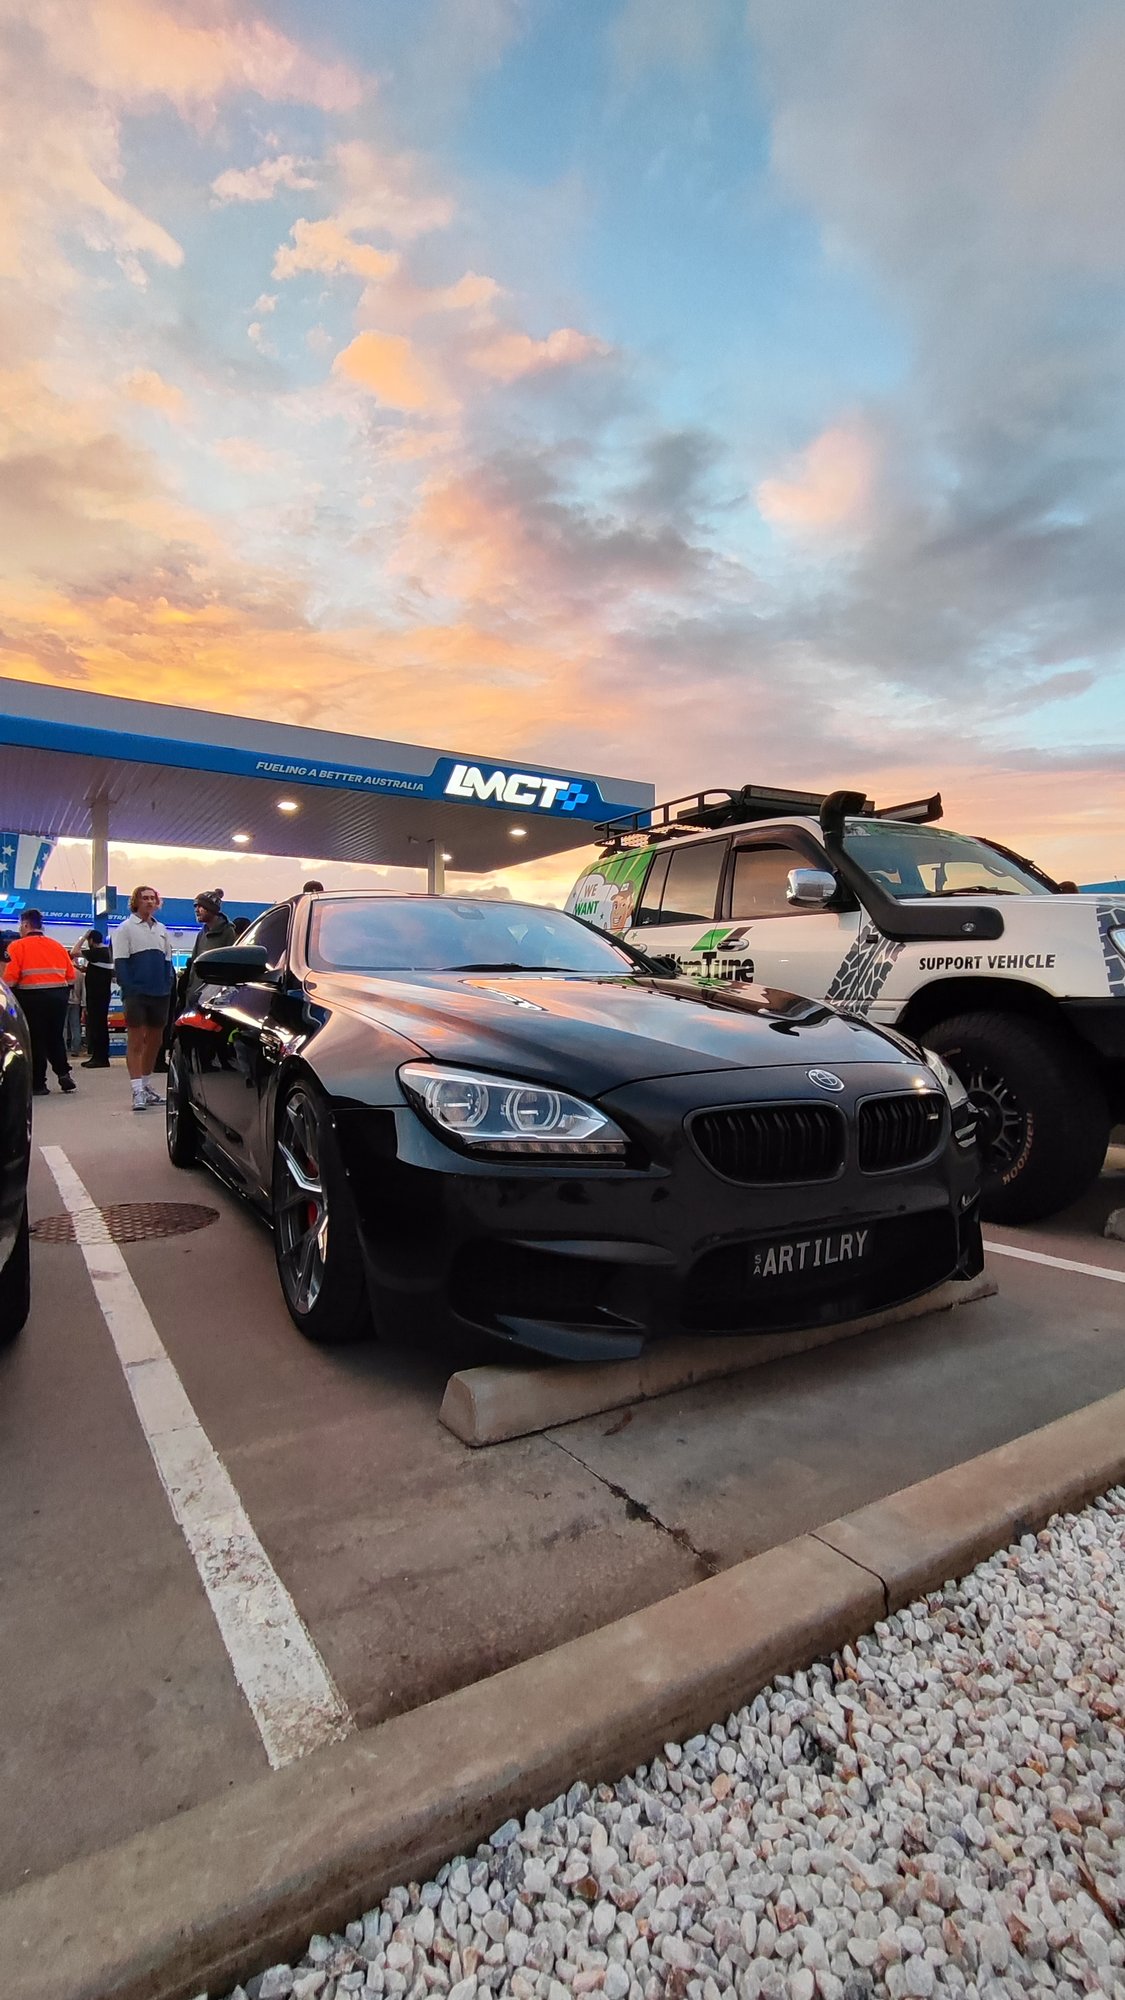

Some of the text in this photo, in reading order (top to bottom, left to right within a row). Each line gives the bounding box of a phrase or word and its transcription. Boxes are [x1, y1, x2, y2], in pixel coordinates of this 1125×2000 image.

[256, 761, 424, 792] FUELING A BETTER AUSTRALIA
[443, 764, 570, 808] LMCT
[584, 883, 599, 898] WE
[574, 900, 600, 916] WANT
[919, 954, 1056, 970] SUPPORT VEHICLE
[762, 1229, 869, 1277] ARTILRY
